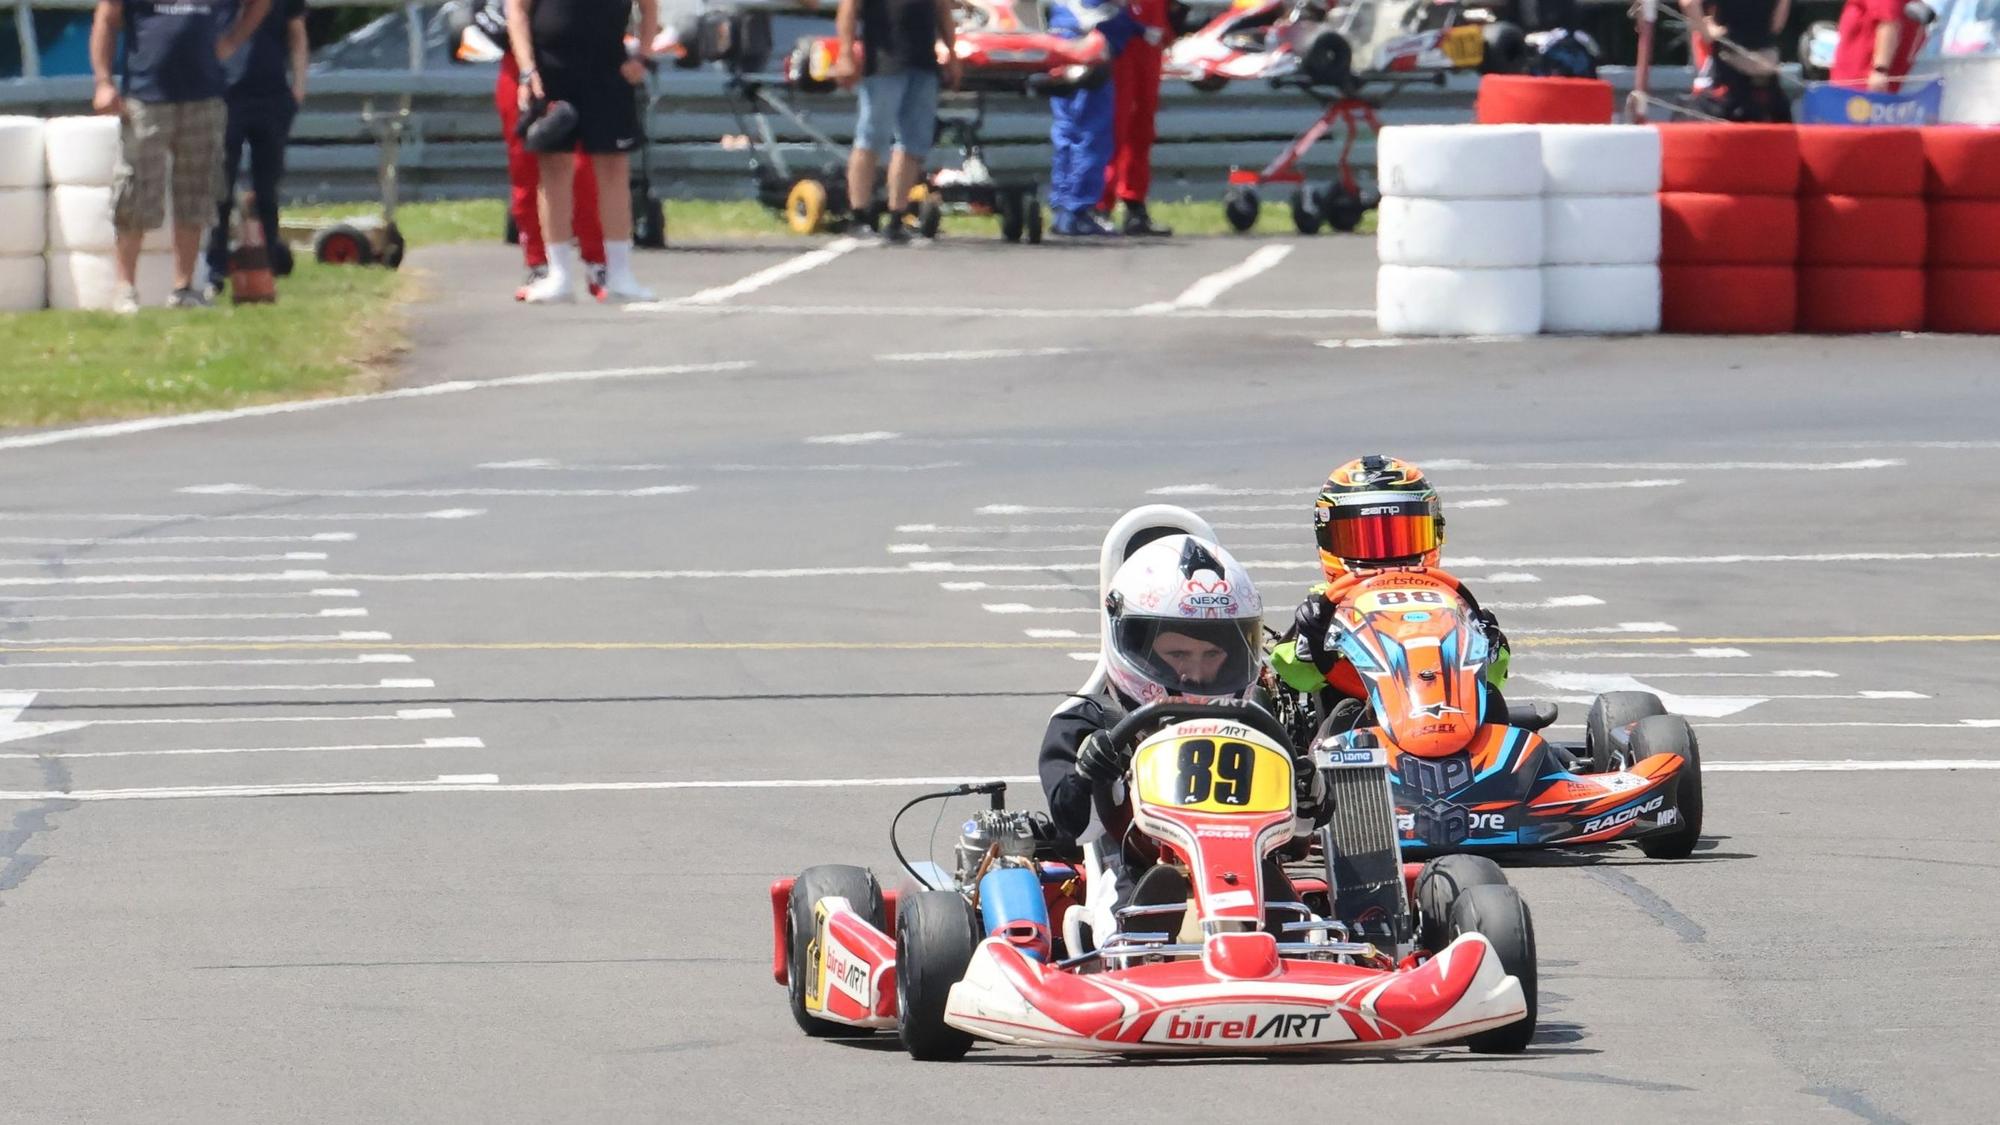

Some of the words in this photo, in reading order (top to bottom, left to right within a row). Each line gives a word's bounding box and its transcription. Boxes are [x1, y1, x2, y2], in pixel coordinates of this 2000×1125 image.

[1360, 506, 1400, 516] zamp
[1190, 596, 1230, 605] NEXO
[1377, 591, 1443, 605] 88
[1176, 725, 1250, 738] birelART
[1174, 739, 1255, 806] 89
[1582, 795, 1664, 834] RACING
[826, 946, 867, 995] birelART
[1167, 1014, 1332, 1039] birelART
